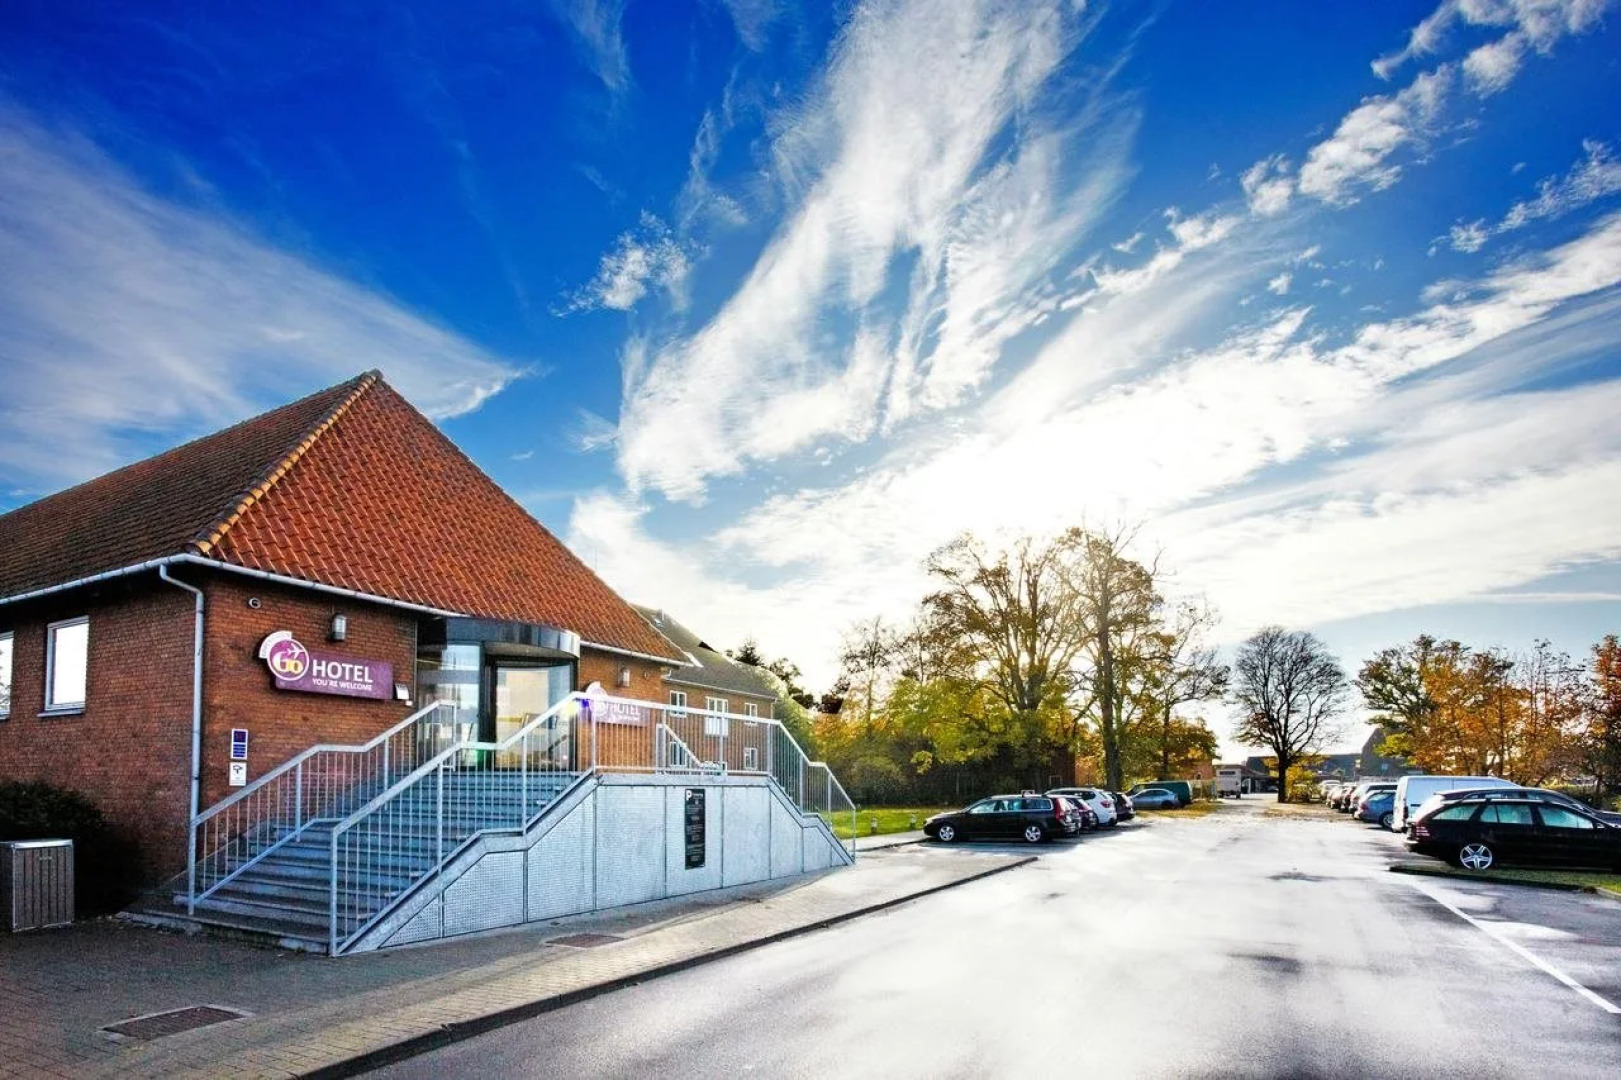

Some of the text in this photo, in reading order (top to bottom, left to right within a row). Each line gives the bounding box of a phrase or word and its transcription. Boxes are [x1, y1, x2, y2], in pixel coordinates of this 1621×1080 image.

[272, 651, 374, 683] Go HOTEL
[339, 681, 373, 691] WELCOME
